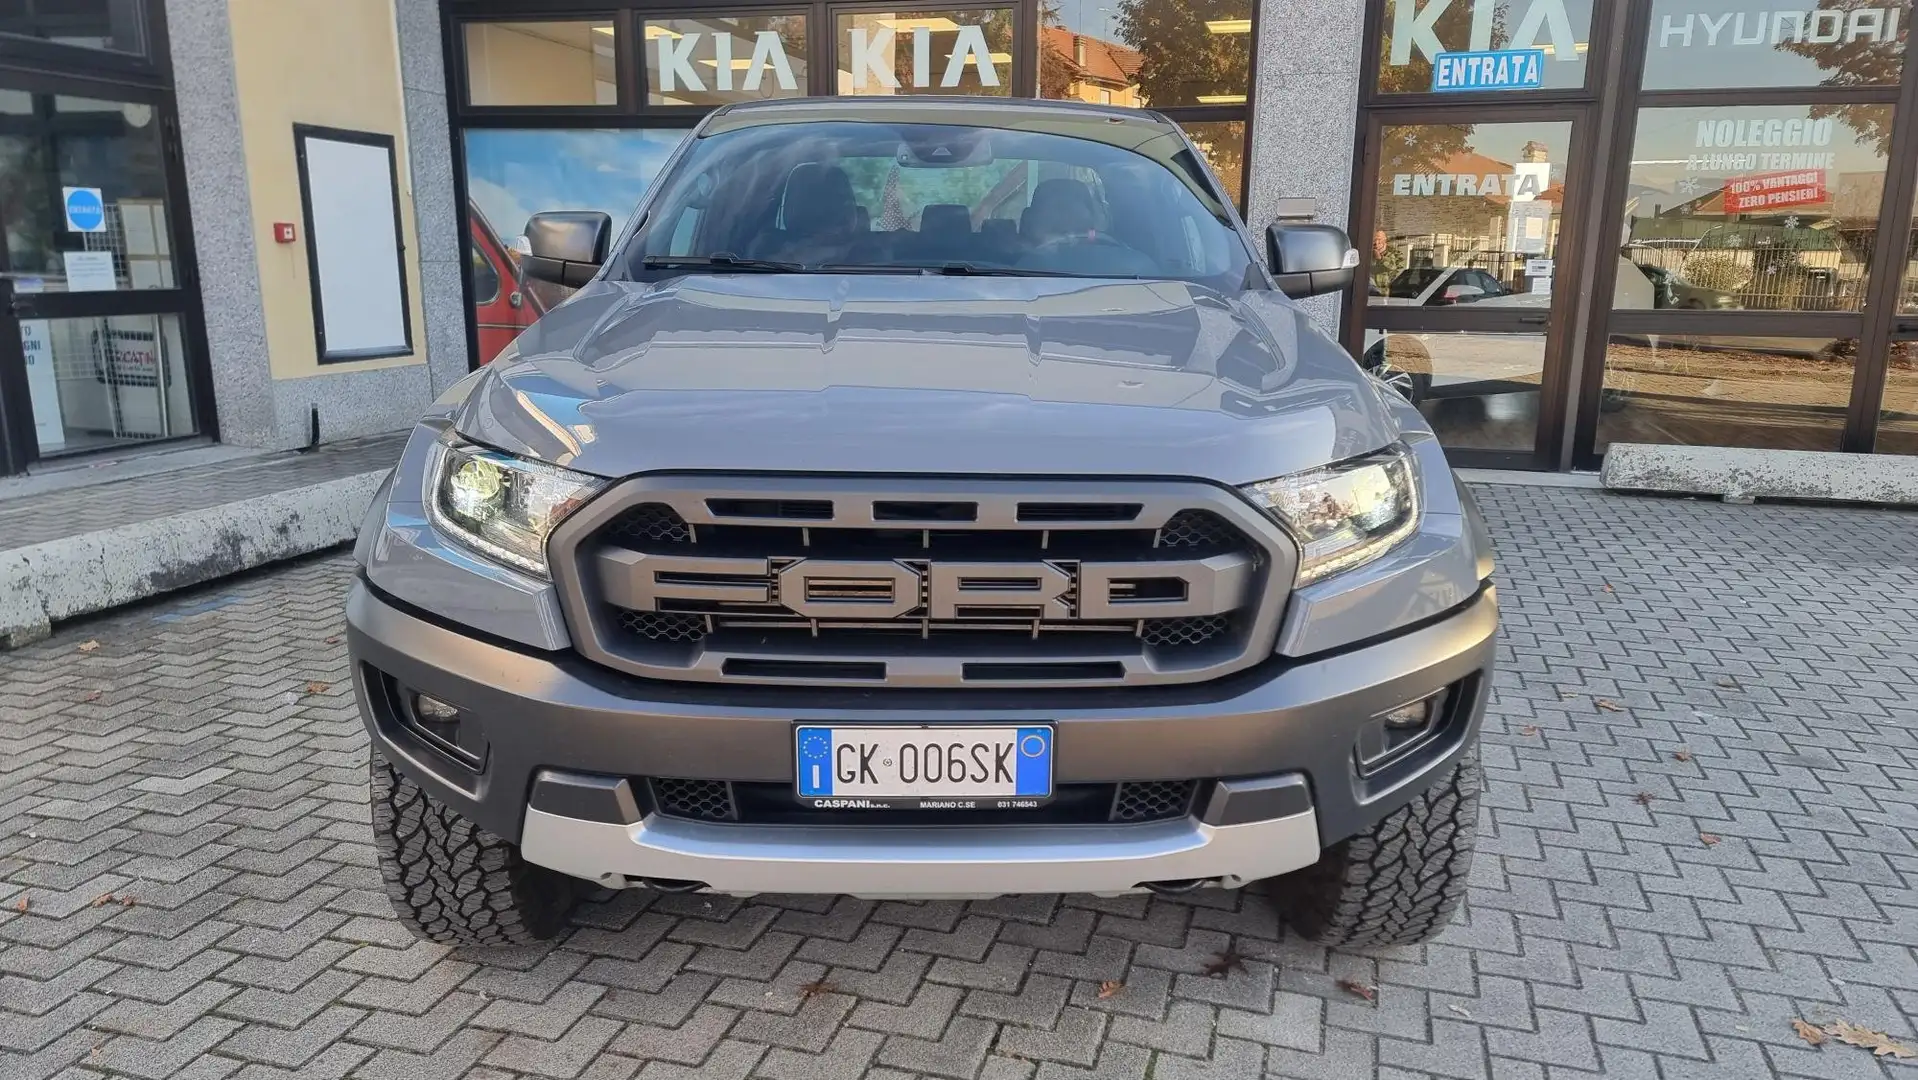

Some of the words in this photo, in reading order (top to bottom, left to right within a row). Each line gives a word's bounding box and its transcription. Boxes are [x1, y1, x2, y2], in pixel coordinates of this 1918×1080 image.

[1659, 8, 1900, 47] HYUNDAI
[654, 31, 798, 91] KIA
[847, 25, 1000, 88] KIA
[1437, 55, 1538, 87] ENTRATA
[1695, 118, 1833, 148] NOLEGGIO
[1686, 154, 1698, 171] A
[1699, 153, 1757, 171] LUNGO
[1760, 152, 1835, 170] TERMINE
[1393, 174, 1541, 196] ENTRATA
[1730, 180, 1760, 194] 100%
[1763, 172, 1818, 188] VANTAGGI
[1739, 195, 1766, 208] ZERO
[600, 551, 1245, 622] FORD
[836, 743, 879, 784] GK
[899, 742, 1014, 784] 006SK
[814, 799, 870, 808] CASPANI
